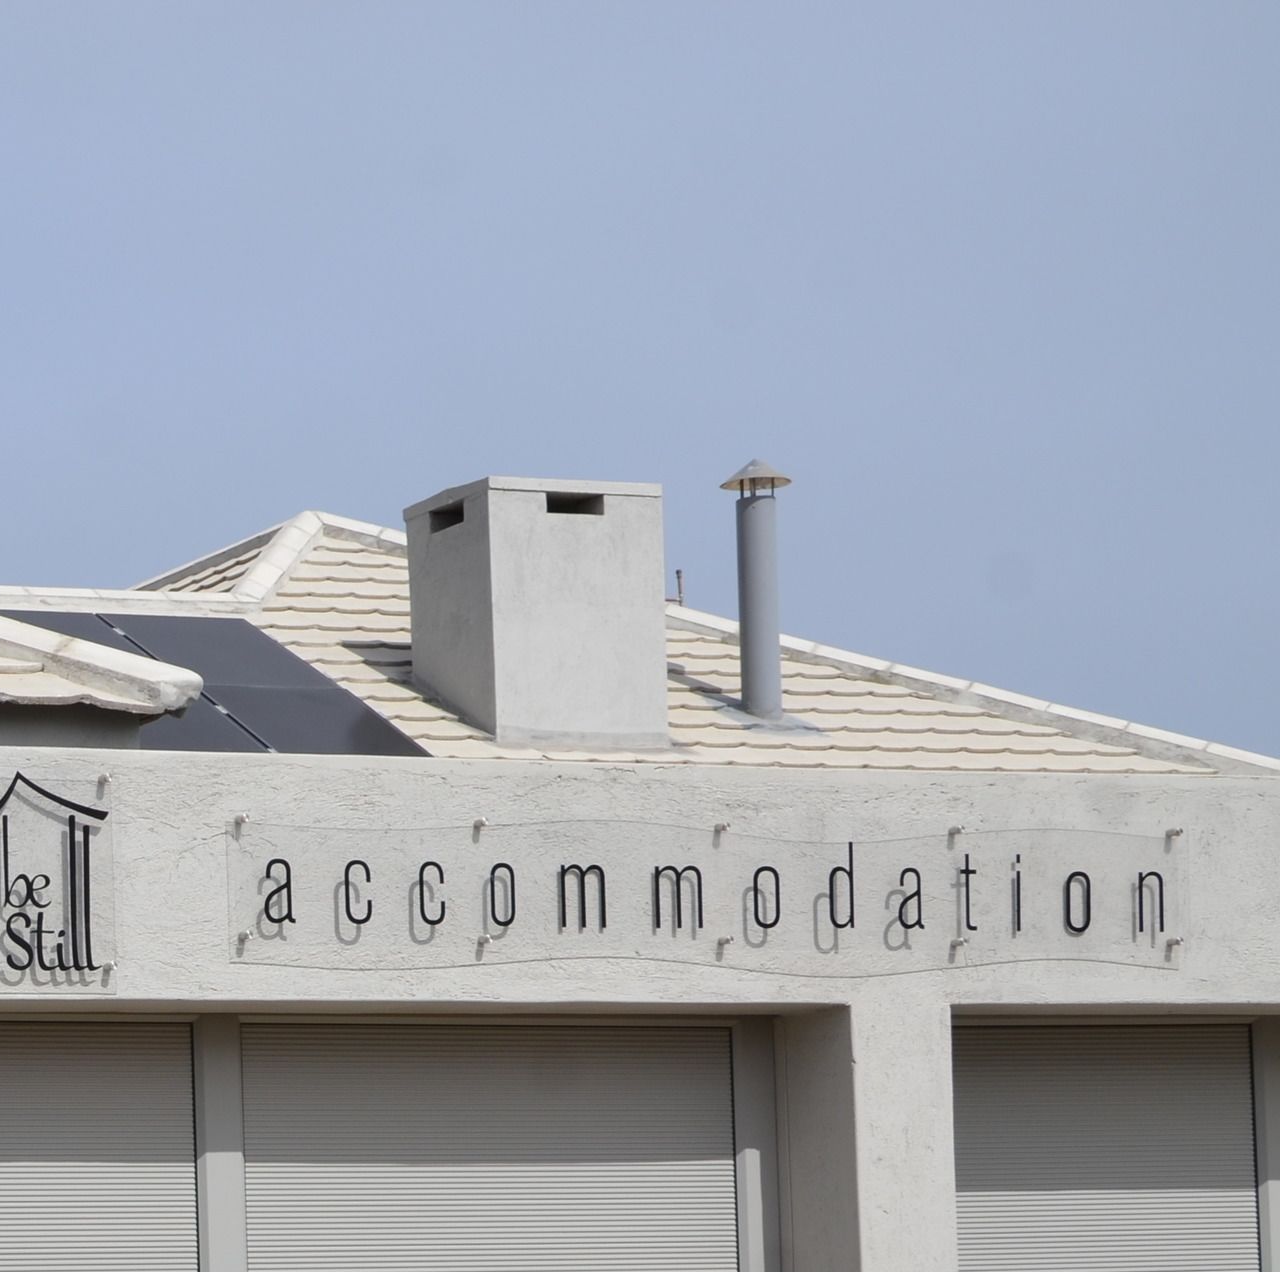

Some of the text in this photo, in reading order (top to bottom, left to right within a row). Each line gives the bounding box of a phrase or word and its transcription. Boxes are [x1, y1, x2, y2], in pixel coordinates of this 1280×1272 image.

[2, 814, 52, 909] be
[5, 814, 103, 972] Still
[262, 841, 1167, 933] accommodation
